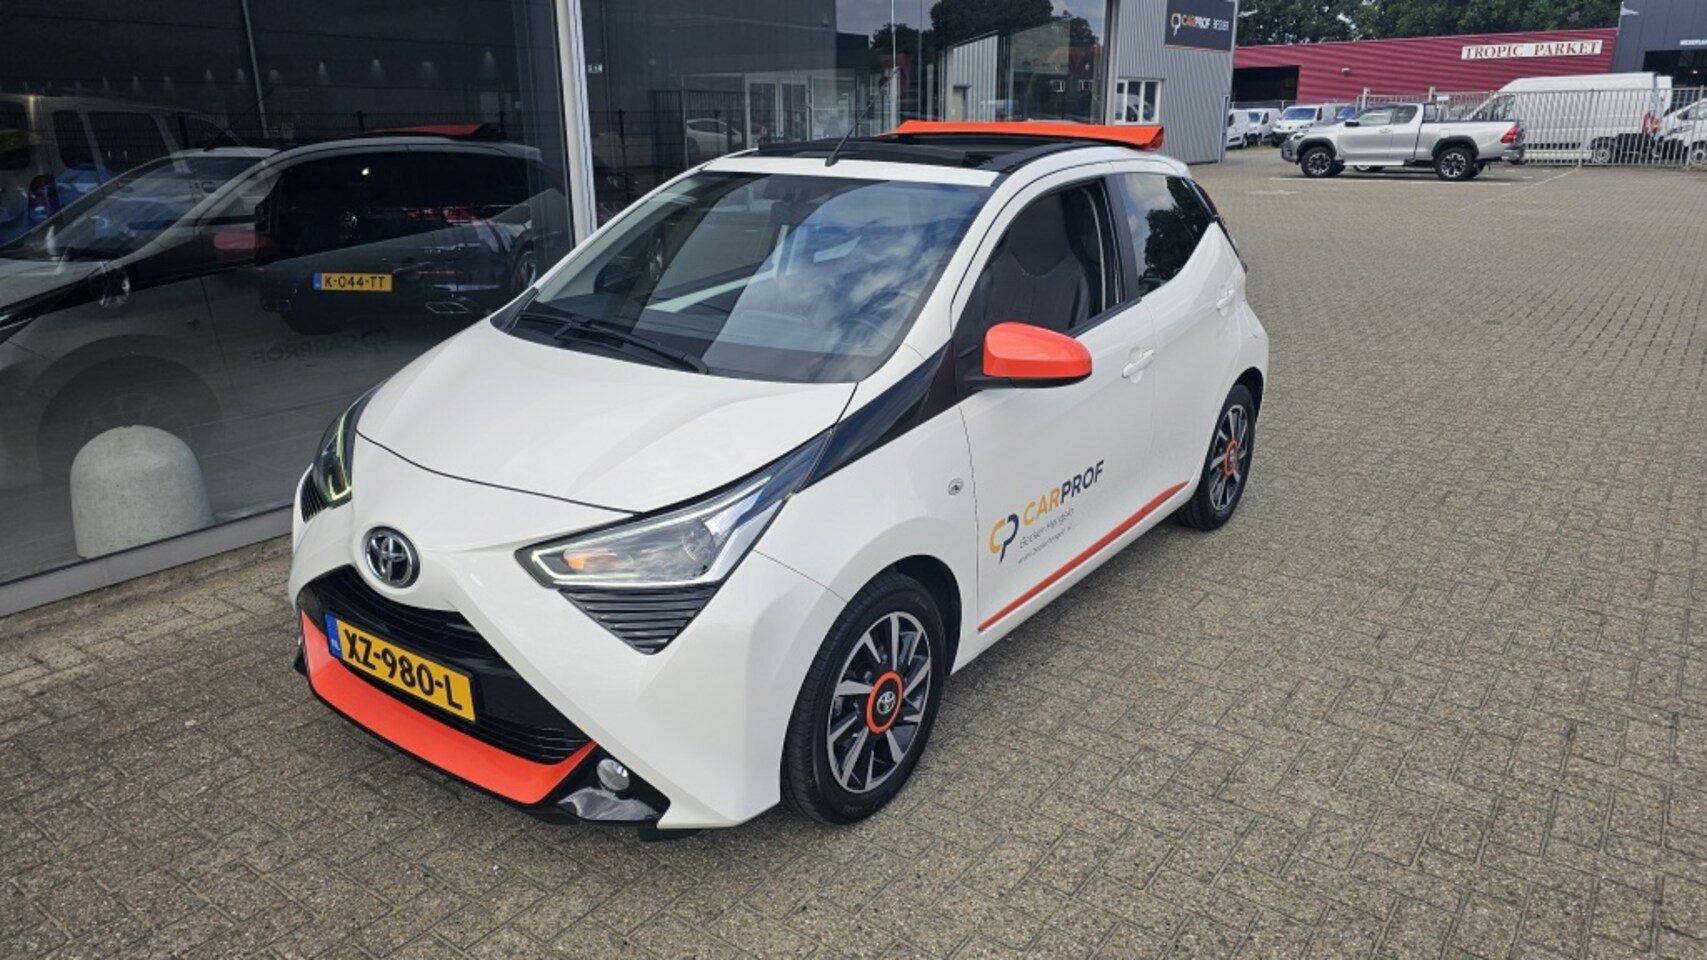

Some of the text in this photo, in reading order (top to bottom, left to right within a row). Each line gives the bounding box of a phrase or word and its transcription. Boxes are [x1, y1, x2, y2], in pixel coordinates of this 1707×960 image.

[1465, 41, 1601, 59] TROPIC PARKET
[324, 275, 386, 289] K-044-TT
[1022, 459, 1104, 526] CARPROF
[344, 628, 463, 711] XZ-980-L
